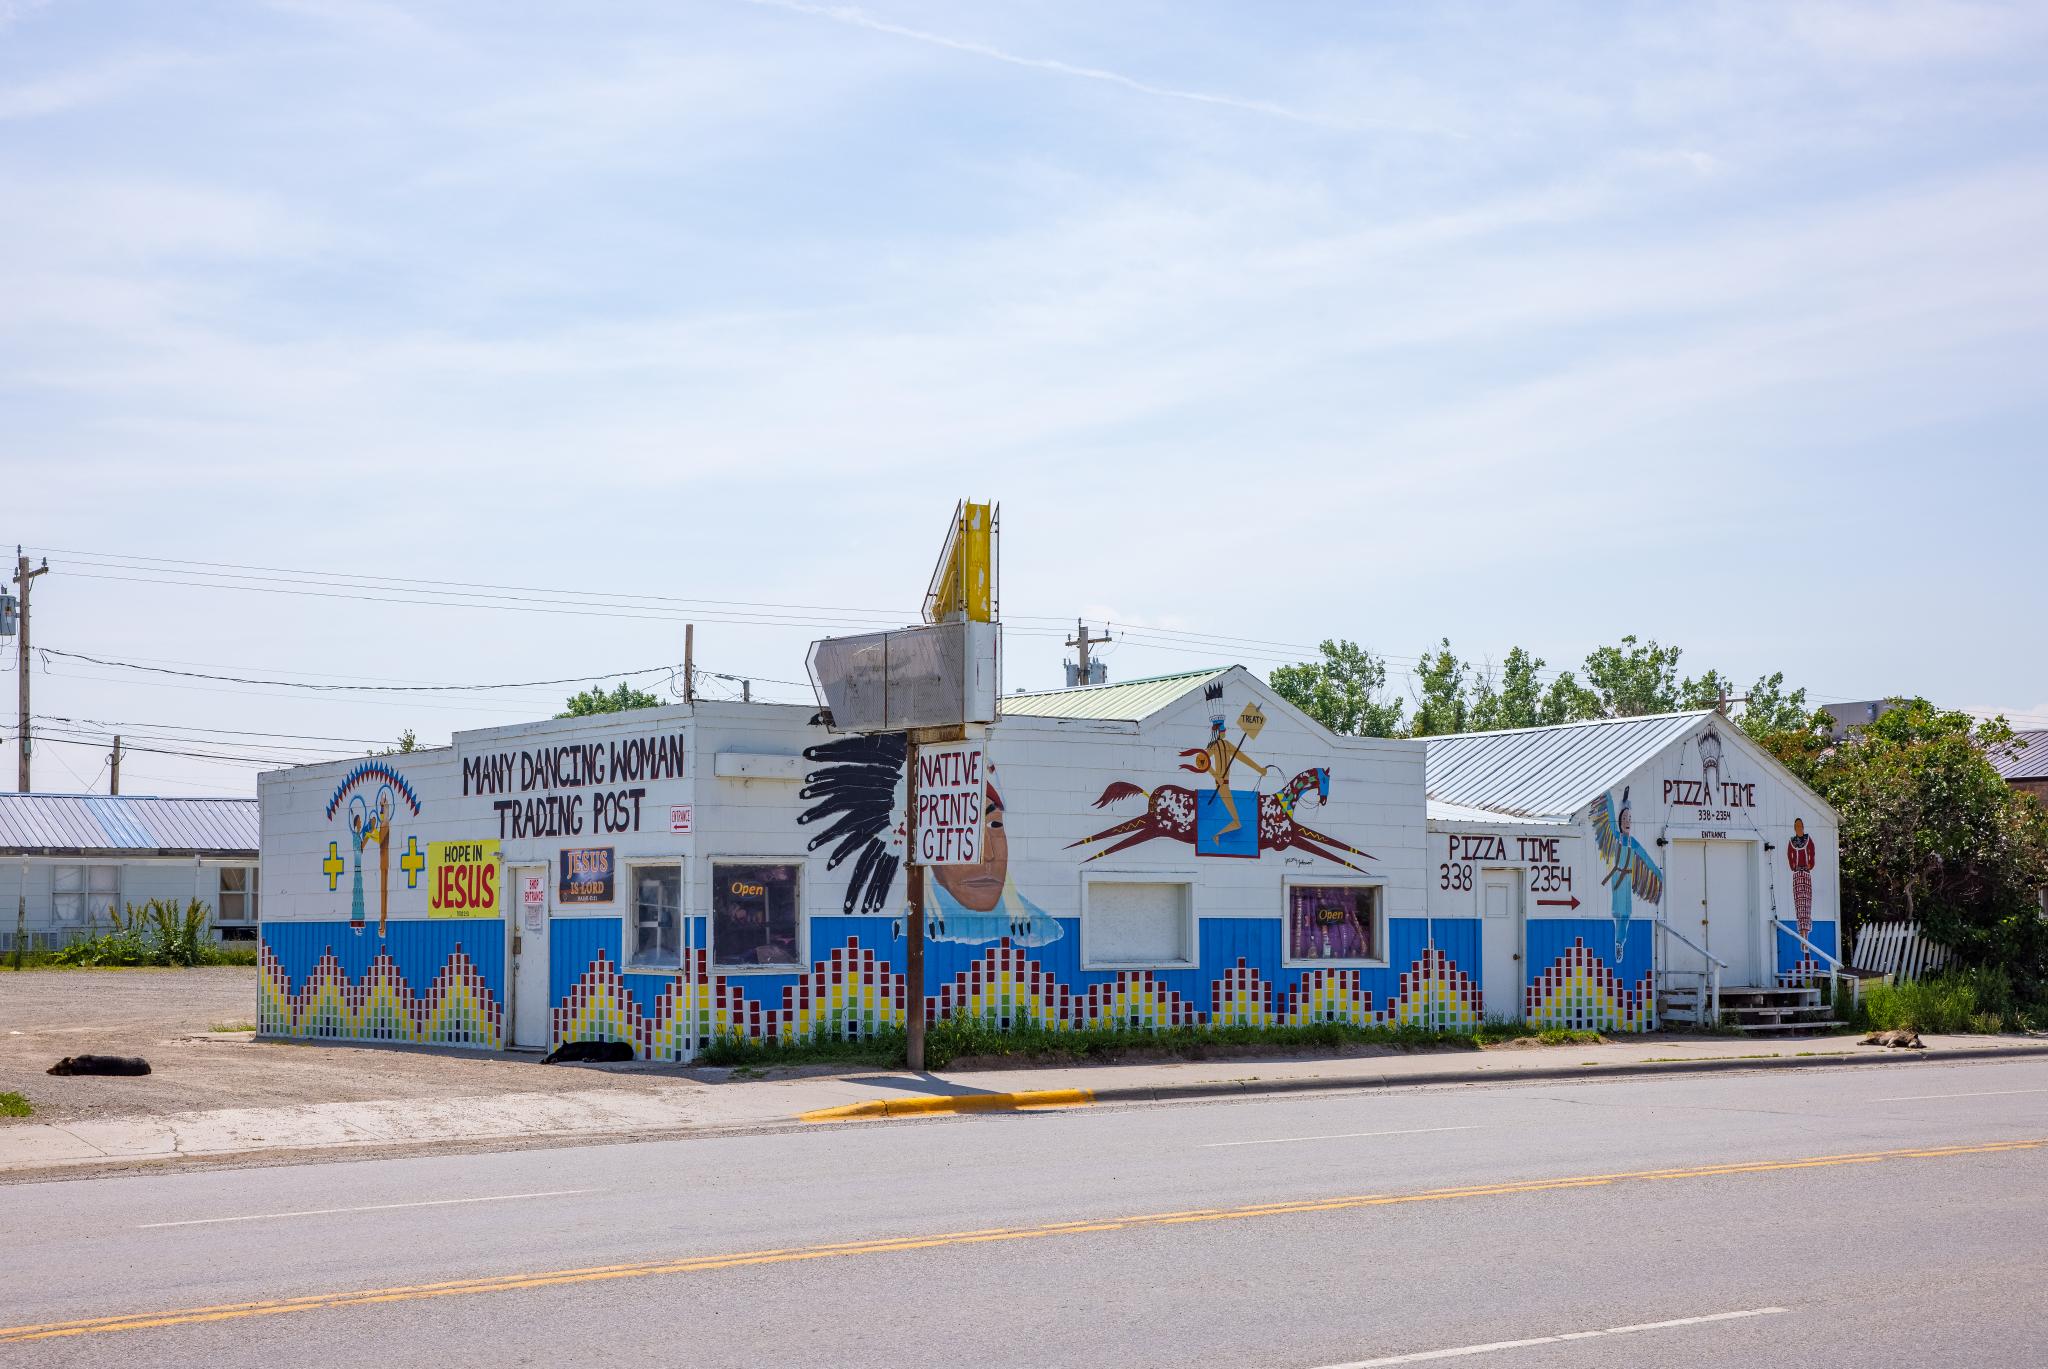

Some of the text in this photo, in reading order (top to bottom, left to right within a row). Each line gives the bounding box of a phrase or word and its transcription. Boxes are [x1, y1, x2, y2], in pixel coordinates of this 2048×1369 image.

[1241, 714, 1264, 724] TREATY
[463, 733, 684, 797] MANY DANCING WOMAN
[920, 751, 982, 788] NATIVE
[1663, 779, 1756, 808] PIZZA TIME
[494, 788, 646, 839] TRADING POST
[671, 809, 691, 823] ENTRANCE
[919, 792, 979, 827] PRINTS
[1698, 809, 1731, 821] 338-2354
[923, 826, 974, 862] GIFTS
[1449, 834, 1560, 863] PIZZA TIME
[1701, 831, 1727, 839] ENTRANCE
[444, 844, 483, 863] HOPE IN
[566, 850, 609, 880] JESUS
[431, 864, 495, 910] JESUS
[570, 881, 605, 895] IS LORD
[731, 881, 764, 896] Open
[1440, 863, 1572, 892] 338 2354
[1319, 909, 1344, 921] Open
